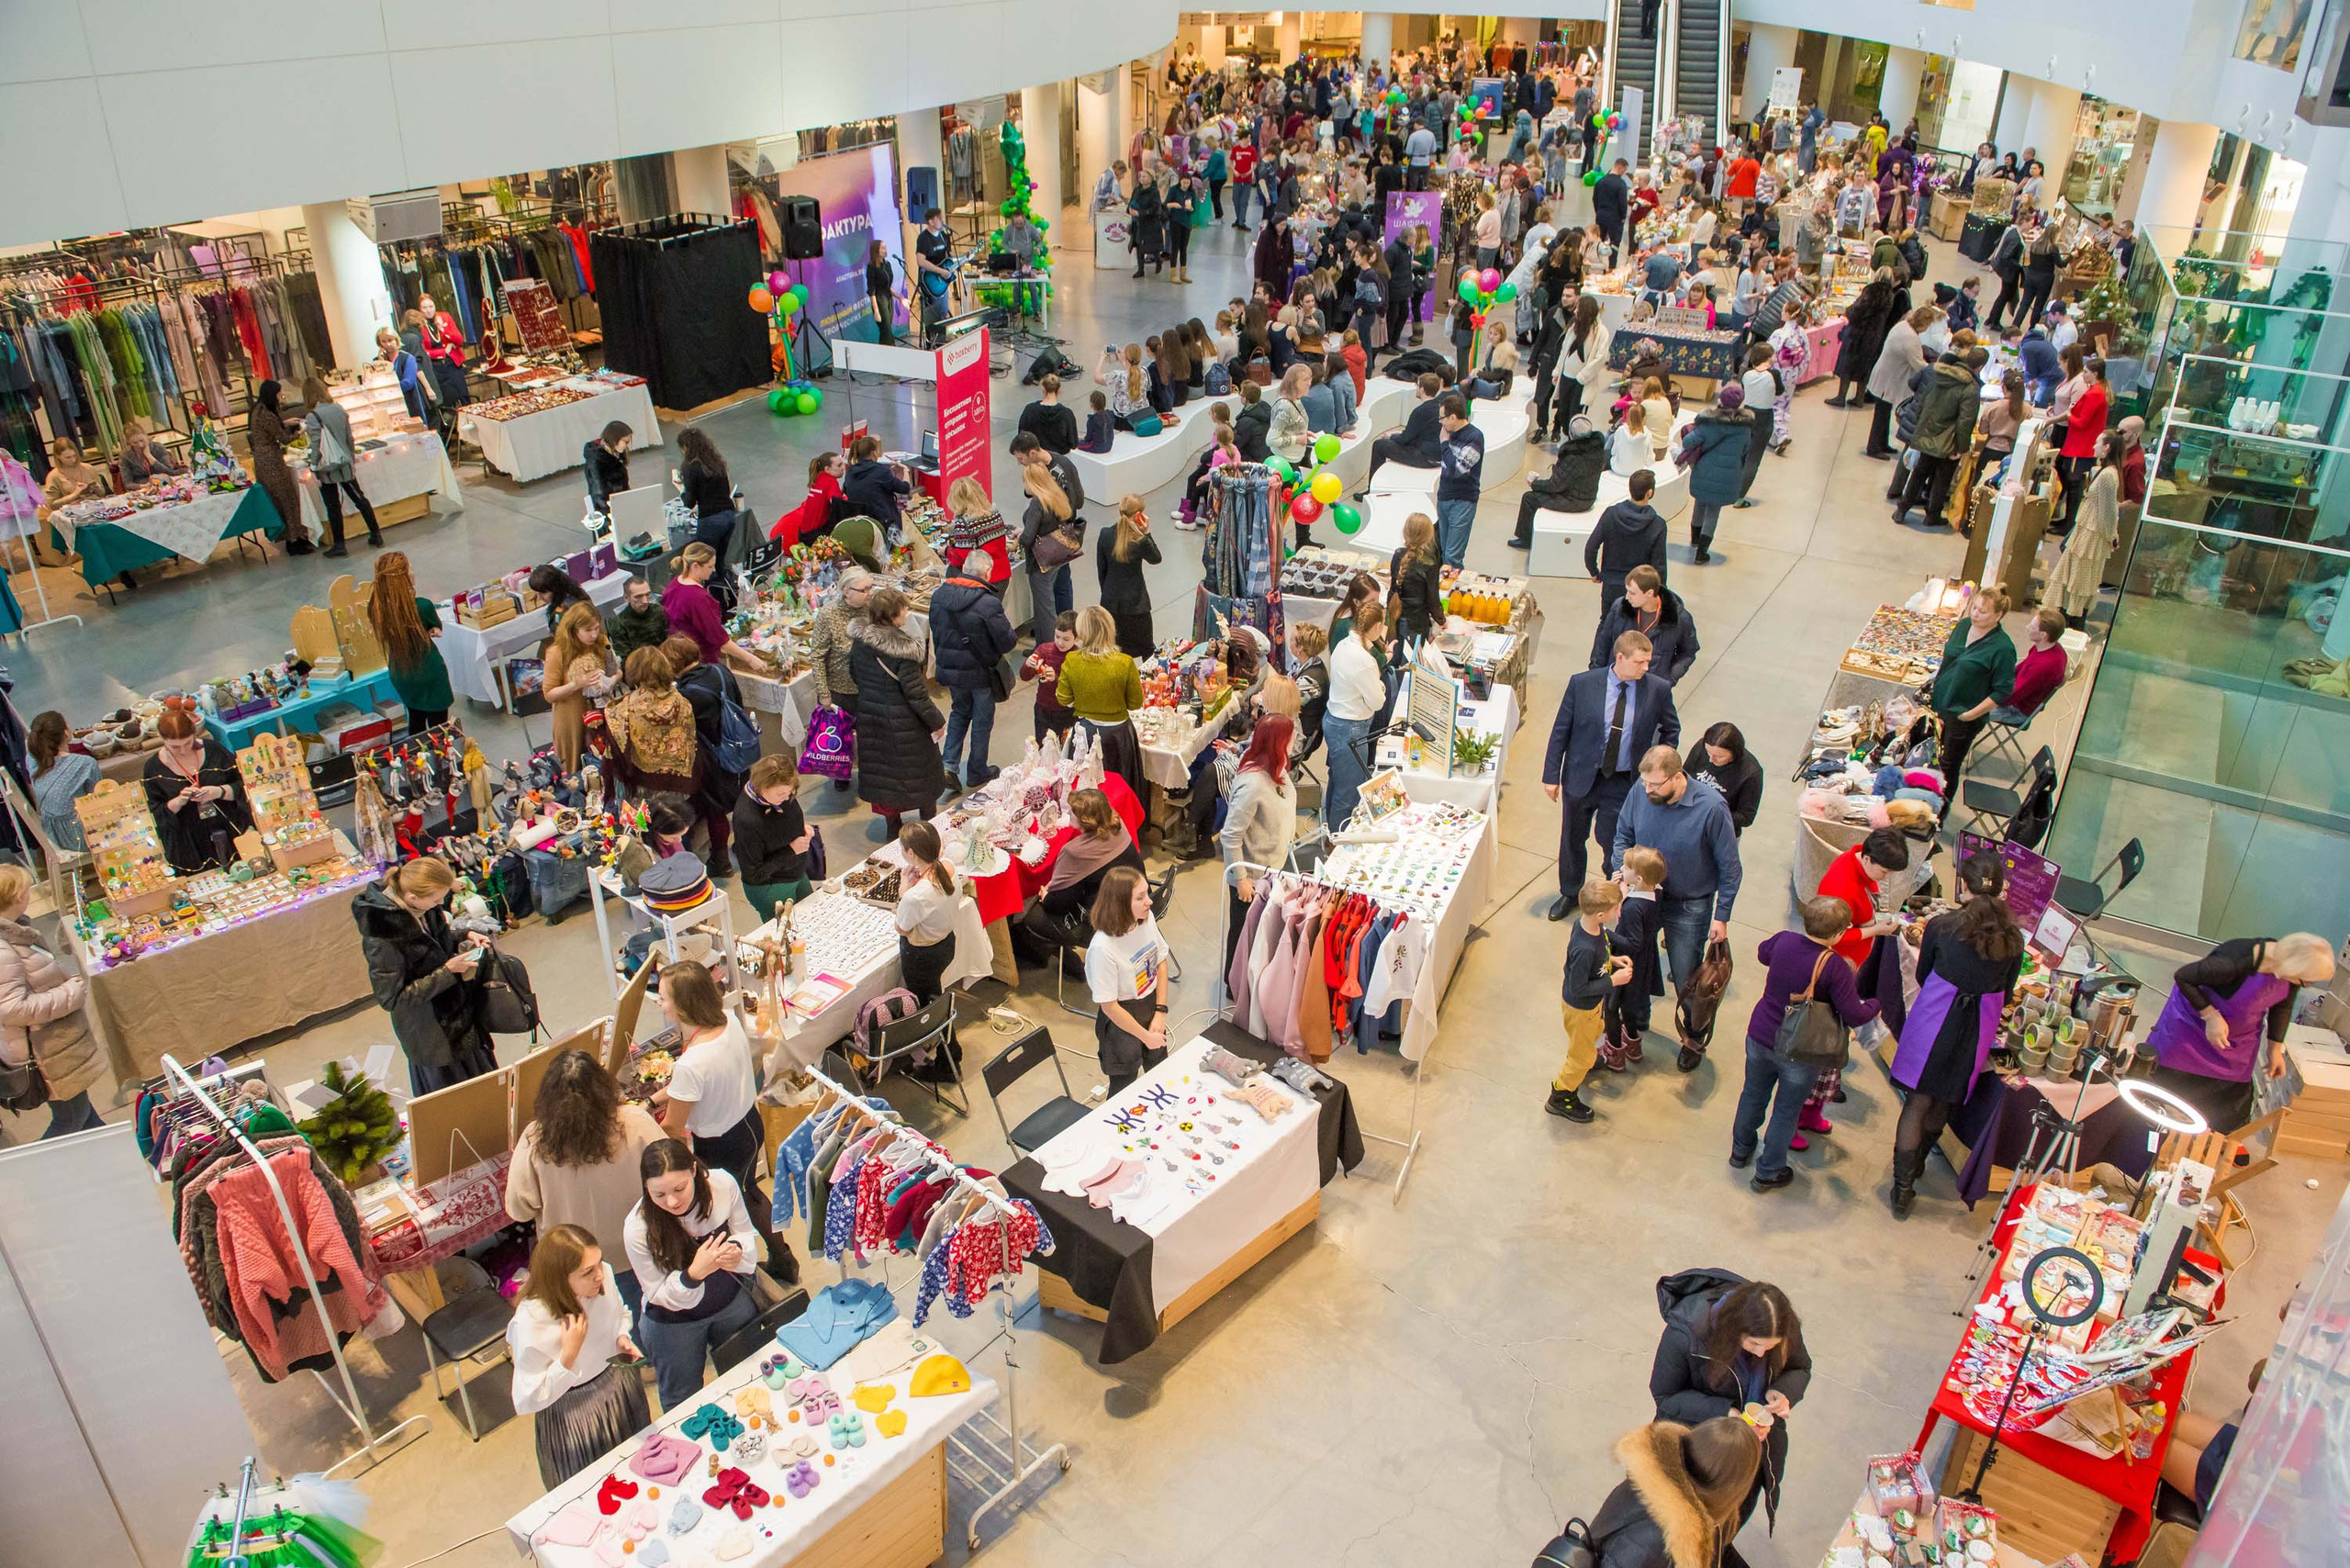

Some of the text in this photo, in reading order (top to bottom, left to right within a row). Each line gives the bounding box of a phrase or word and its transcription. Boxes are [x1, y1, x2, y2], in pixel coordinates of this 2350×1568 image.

[1393, 219, 1432, 228] ШАФРАН
[955, 342, 978, 359] boxberry
[755, 547, 766, 563] 5
